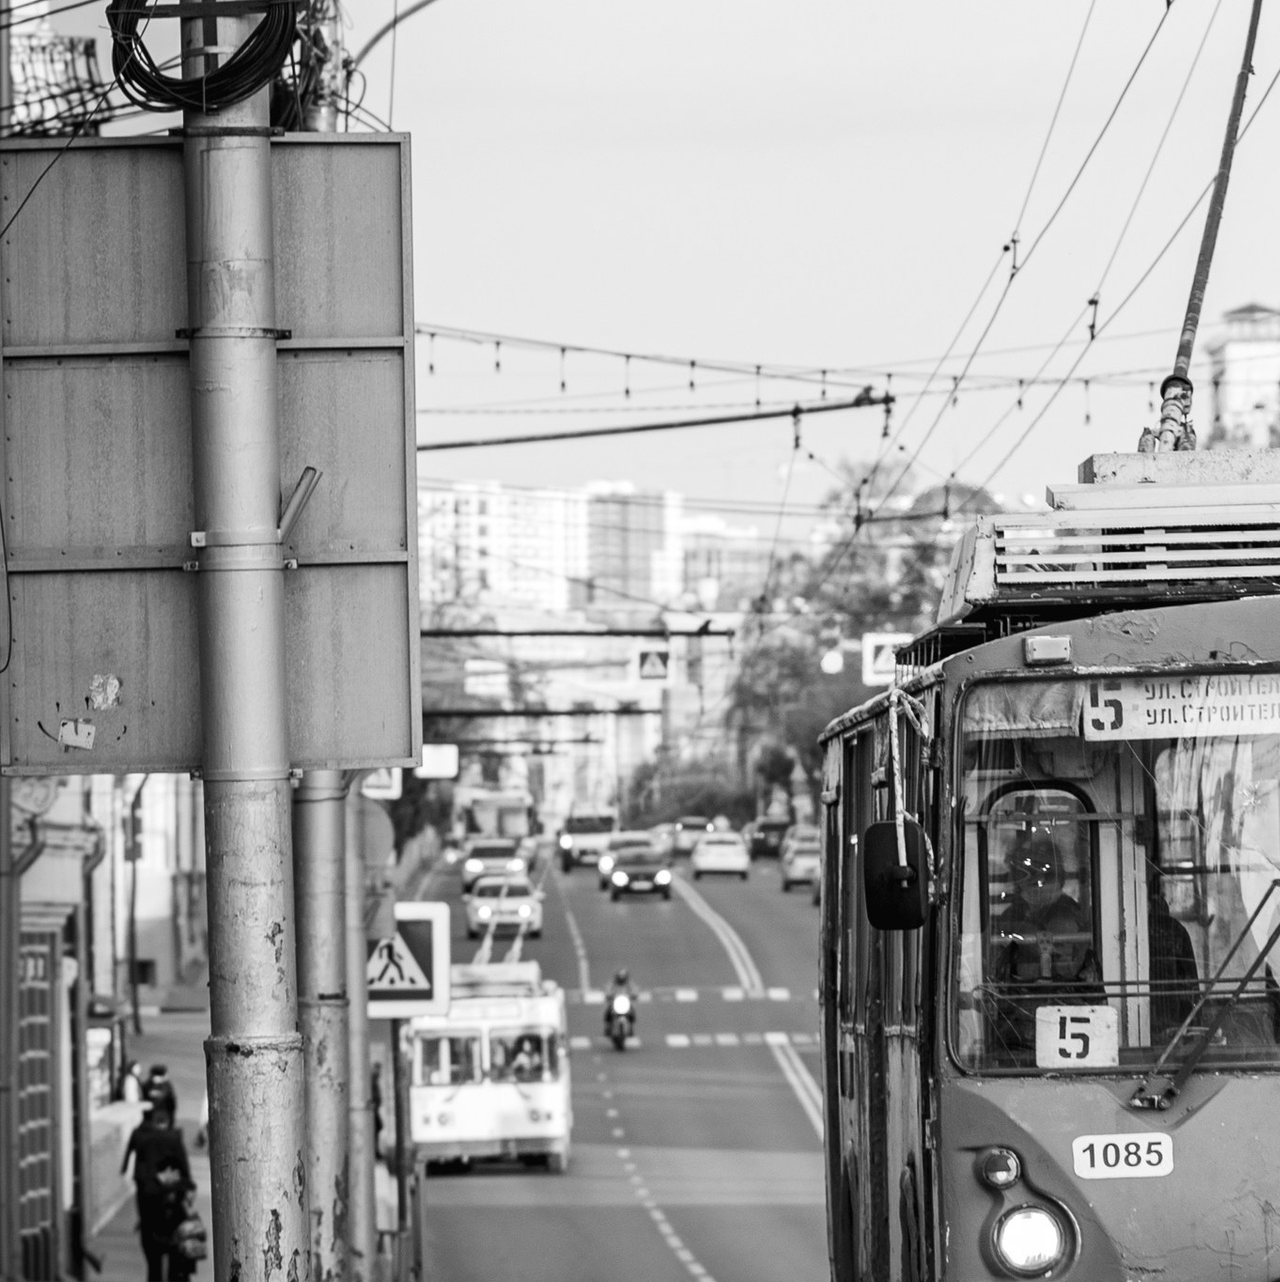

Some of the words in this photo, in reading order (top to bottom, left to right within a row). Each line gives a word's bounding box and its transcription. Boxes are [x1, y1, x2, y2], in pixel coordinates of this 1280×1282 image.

[1090, 682, 1123, 730] 5
[1058, 1016, 1091, 1059] 5
[1082, 1141, 1163, 1168] 1085
